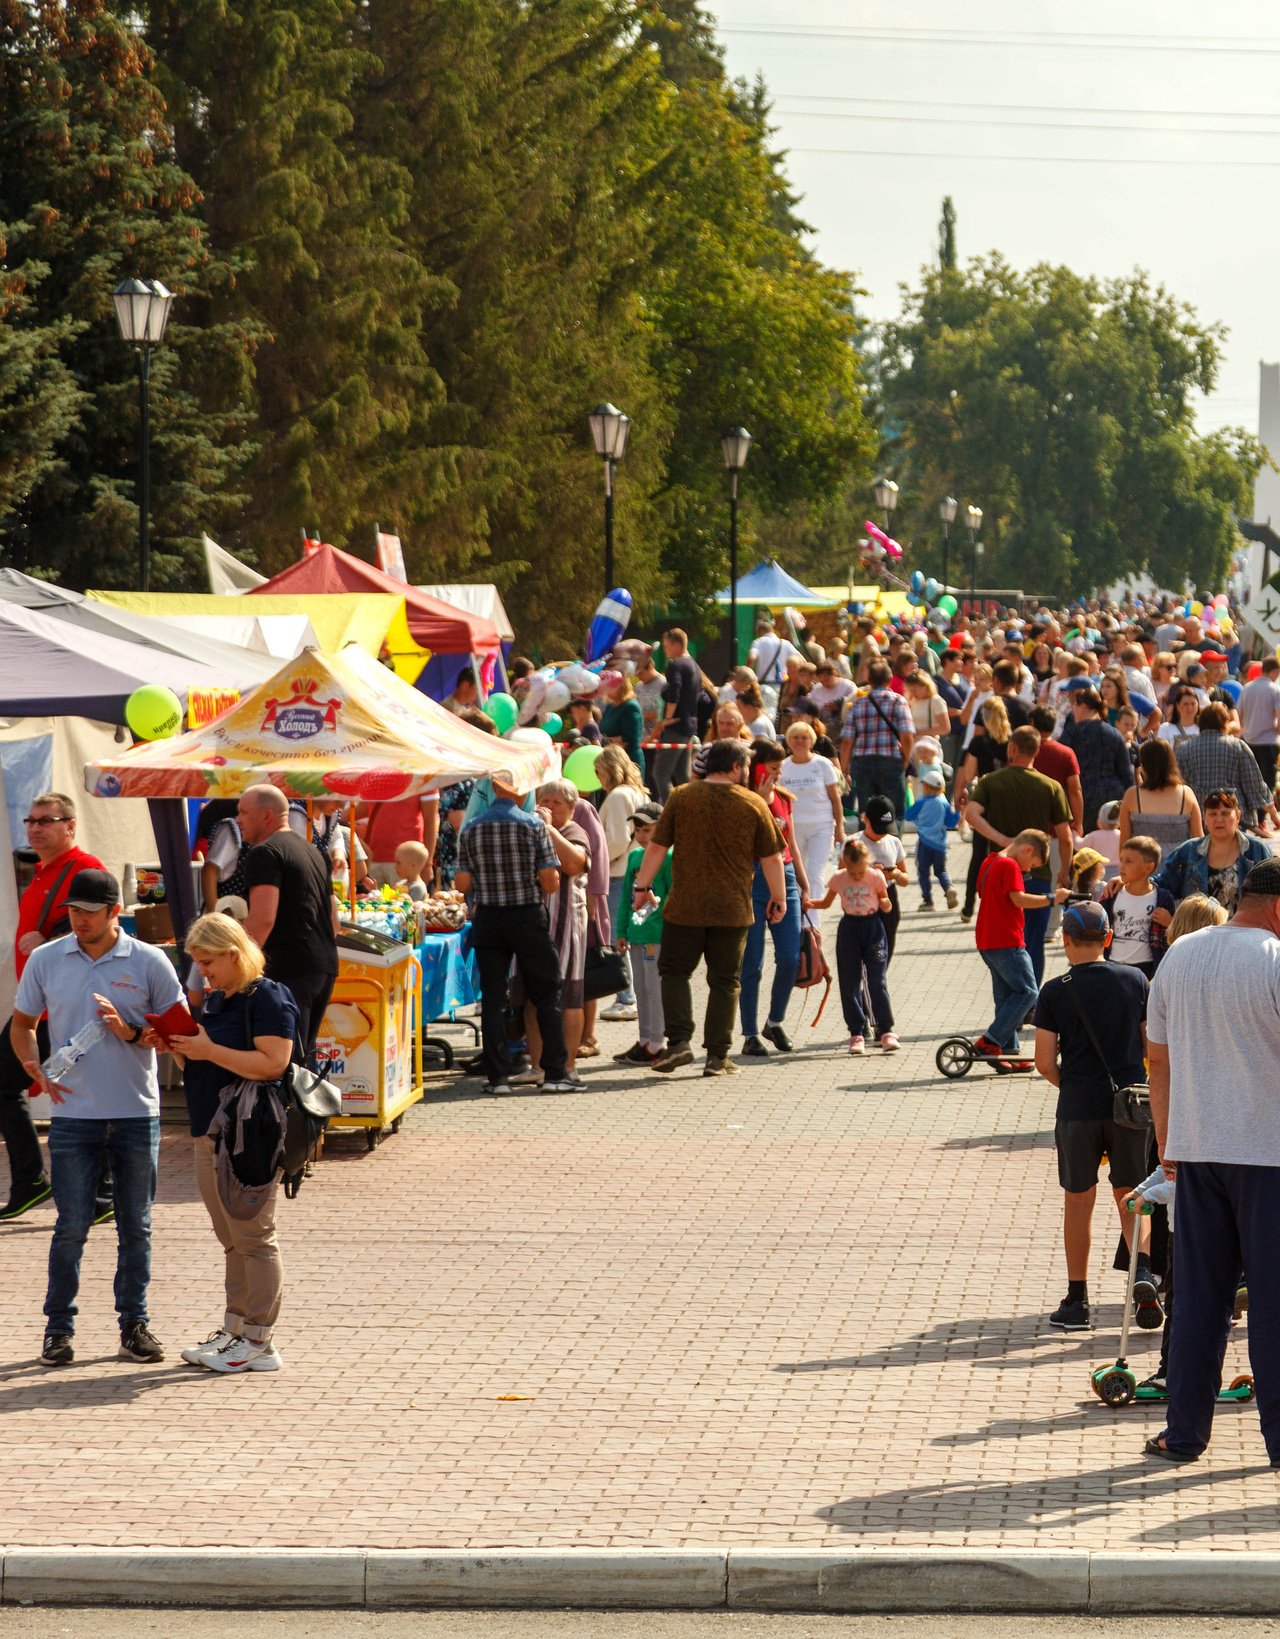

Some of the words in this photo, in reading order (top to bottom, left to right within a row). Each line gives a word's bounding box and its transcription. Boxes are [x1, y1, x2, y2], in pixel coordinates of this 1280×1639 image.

[214, 728, 236, 745] Вкус
[244, 746, 310, 759] качество
[314, 748, 336, 758] без
